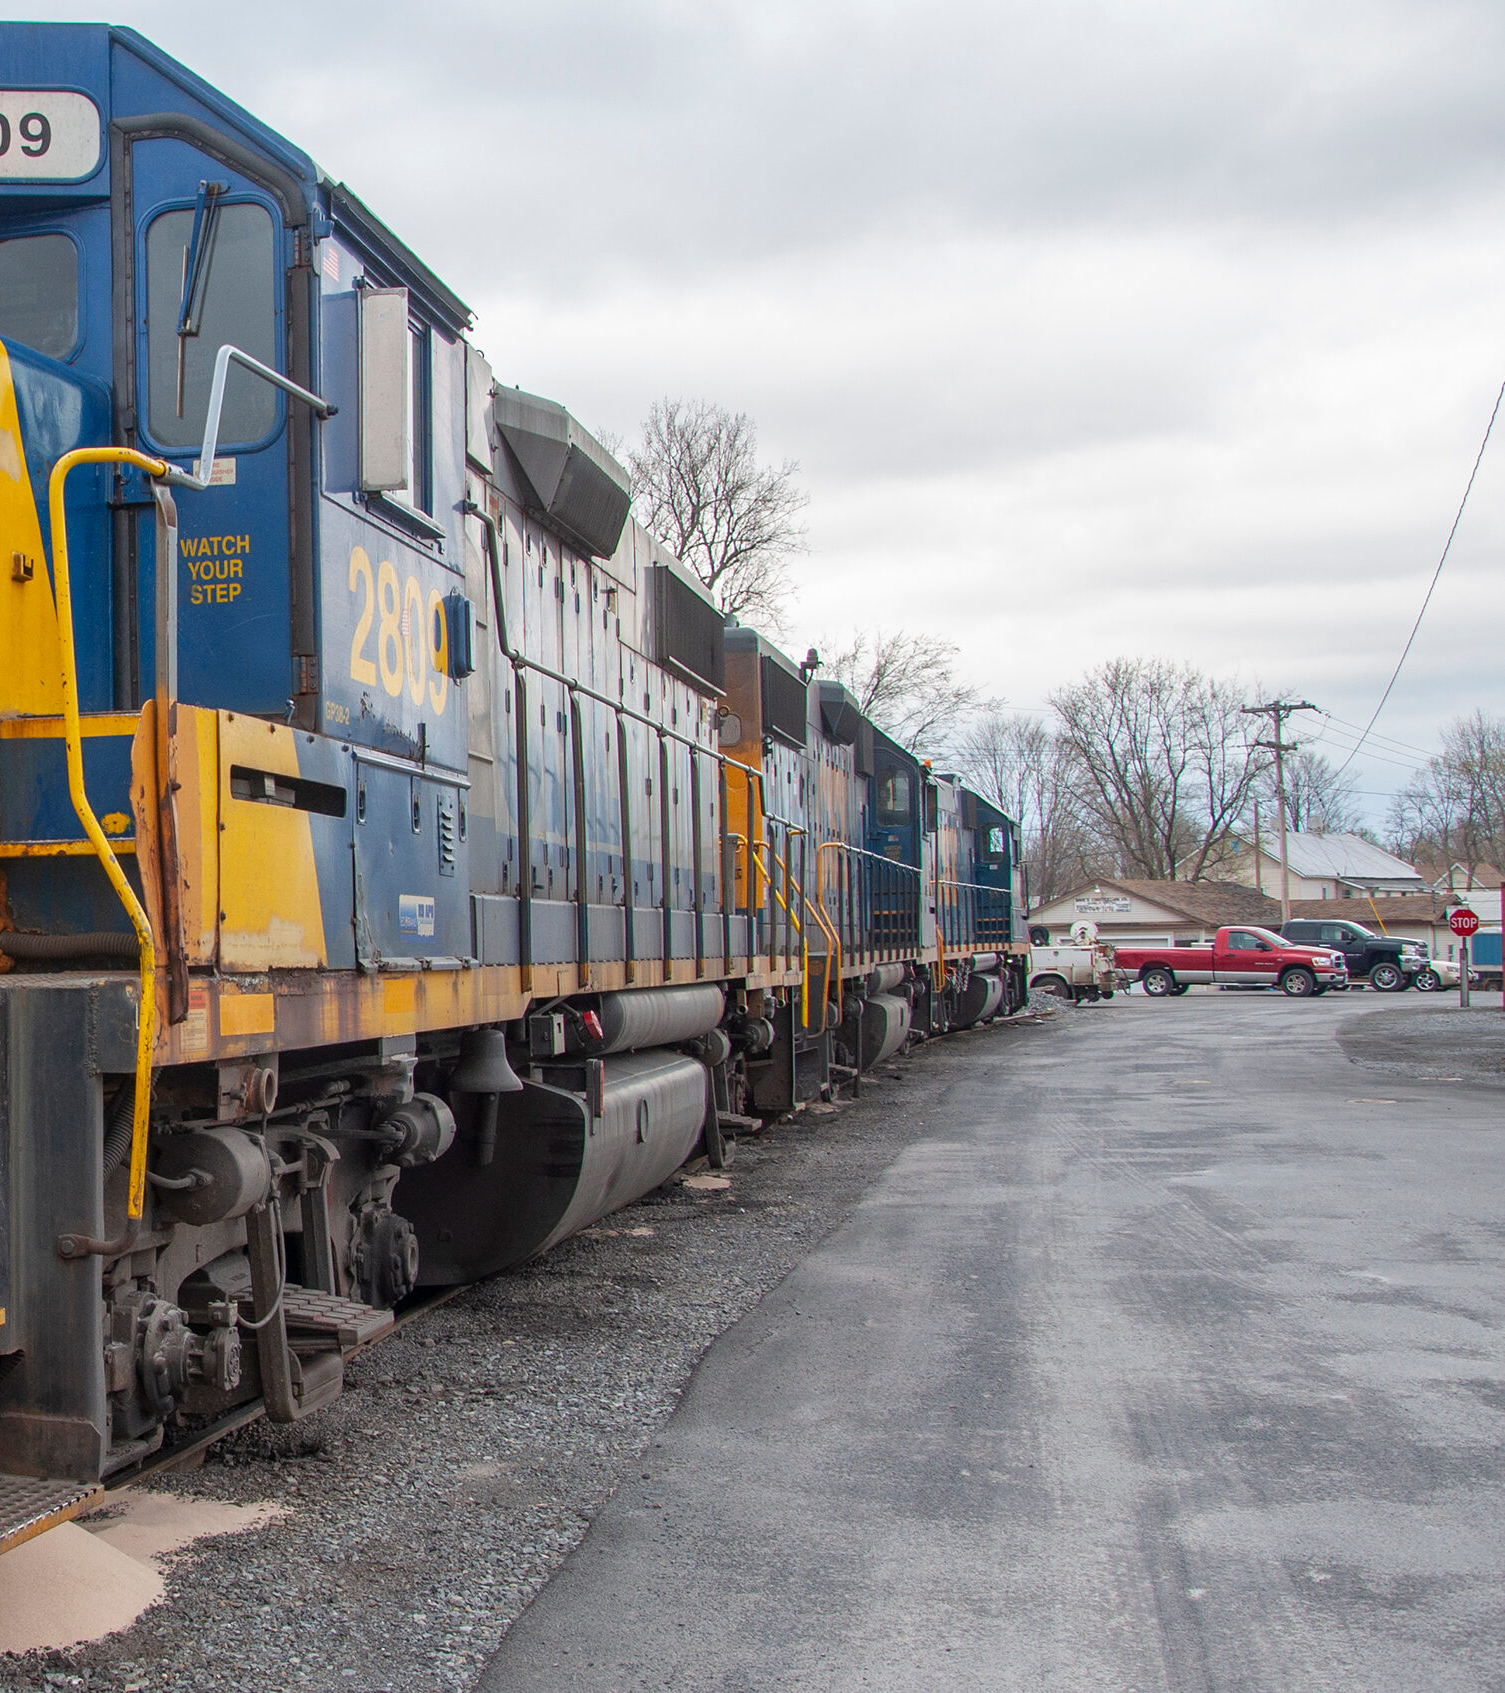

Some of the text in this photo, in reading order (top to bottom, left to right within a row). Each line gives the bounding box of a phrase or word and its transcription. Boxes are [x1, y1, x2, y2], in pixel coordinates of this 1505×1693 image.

[180, 535, 250, 558] WATCH
[188, 559, 243, 580] YOUR
[190, 583, 242, 605] STEP
[349, 545, 449, 716] 2809
[325, 701, 350, 725] GP38-2
[1450, 917, 1477, 929] STOP
